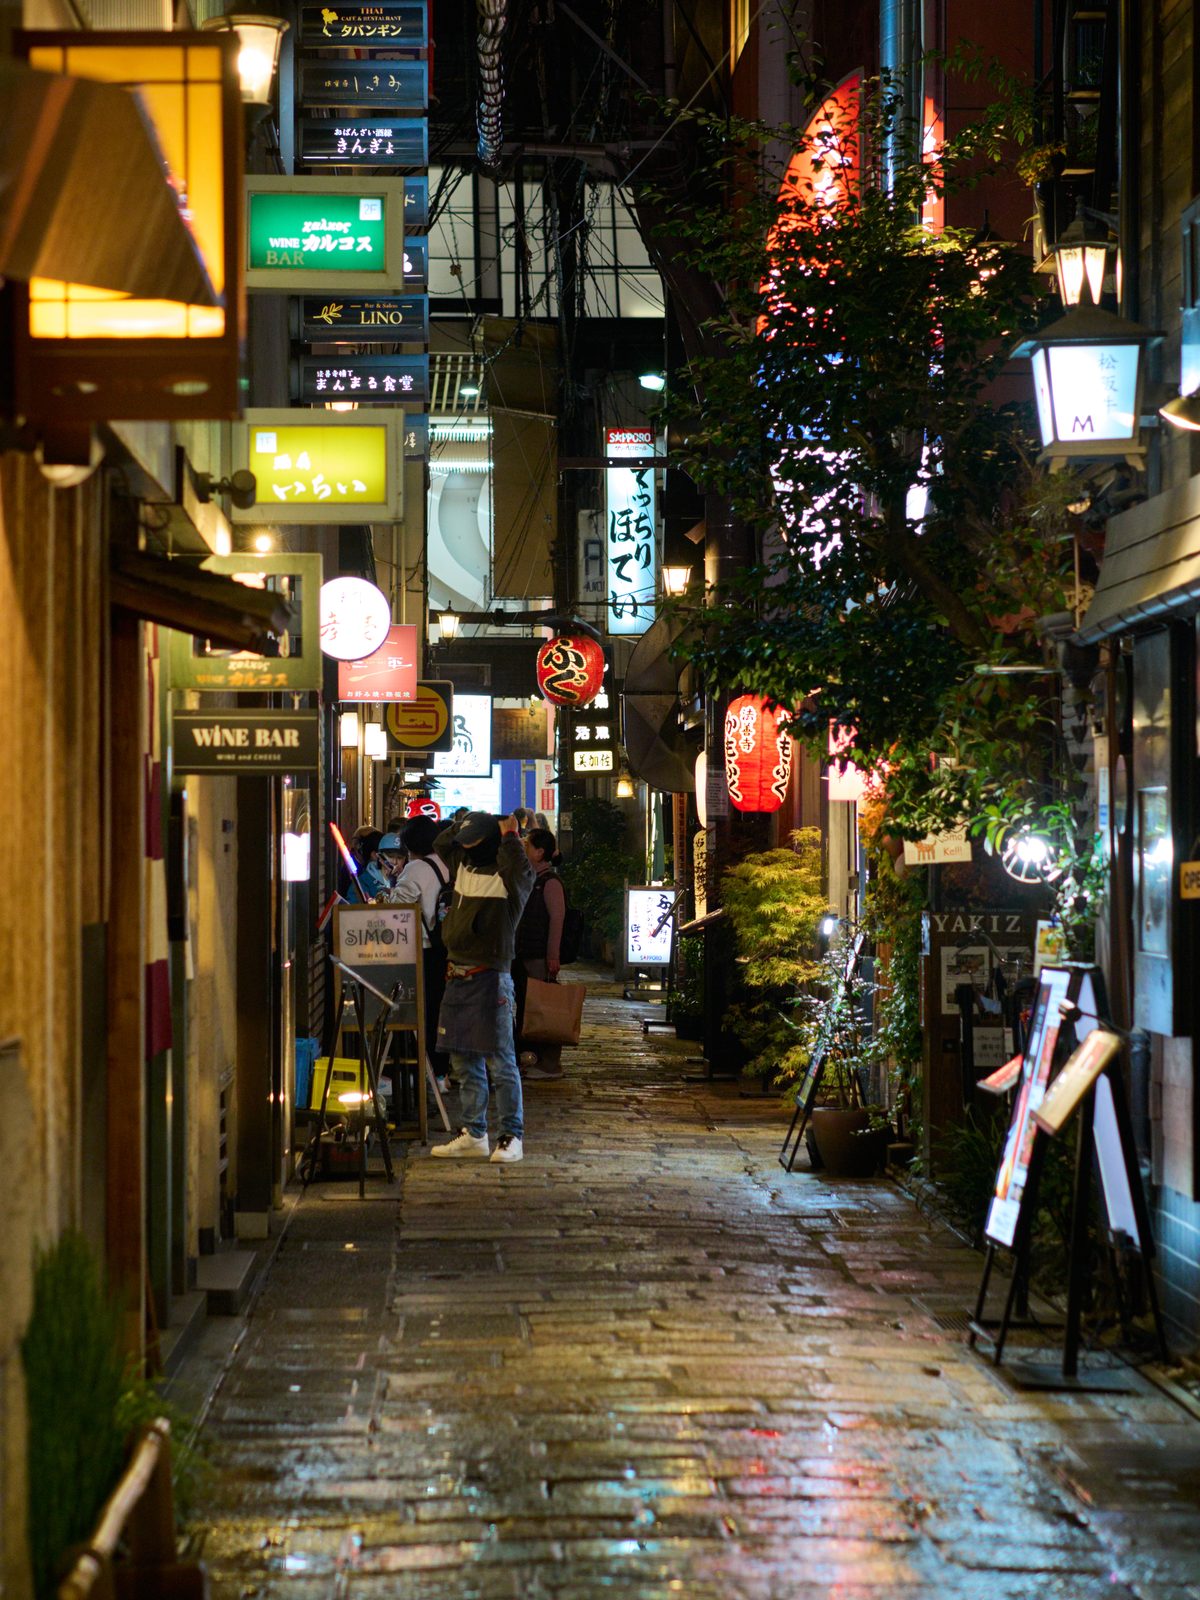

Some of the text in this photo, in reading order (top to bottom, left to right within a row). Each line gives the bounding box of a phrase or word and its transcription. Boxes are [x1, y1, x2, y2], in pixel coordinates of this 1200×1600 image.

[360, 7, 383, 15] THAI
[341, 24, 402, 37] タバンギン
[337, 138, 394, 155] きんぎょ
[269, 237, 300, 249] WINE
[302, 234, 373, 252] カルコス
[266, 250, 304, 265] BAR
[360, 311, 403, 325] LINO
[316, 374, 414, 391] まんまる食堂
[1072, 415, 1095, 433] M
[609, 431, 651, 443] SAPPORO
[272, 473, 367, 500] いちい
[630, 468, 653, 570] てっちり
[610, 508, 638, 619] ほてい
[542, 639, 589, 701] ふぐ
[228, 671, 289, 687] カルコス
[256, 728, 300, 747] BAR
[741, 707, 755, 751] 法善寺
[217, 753, 282, 761] WINE and CHEESE
[399, 912, 411, 923] 2F
[345, 928, 409, 946] SIMON
